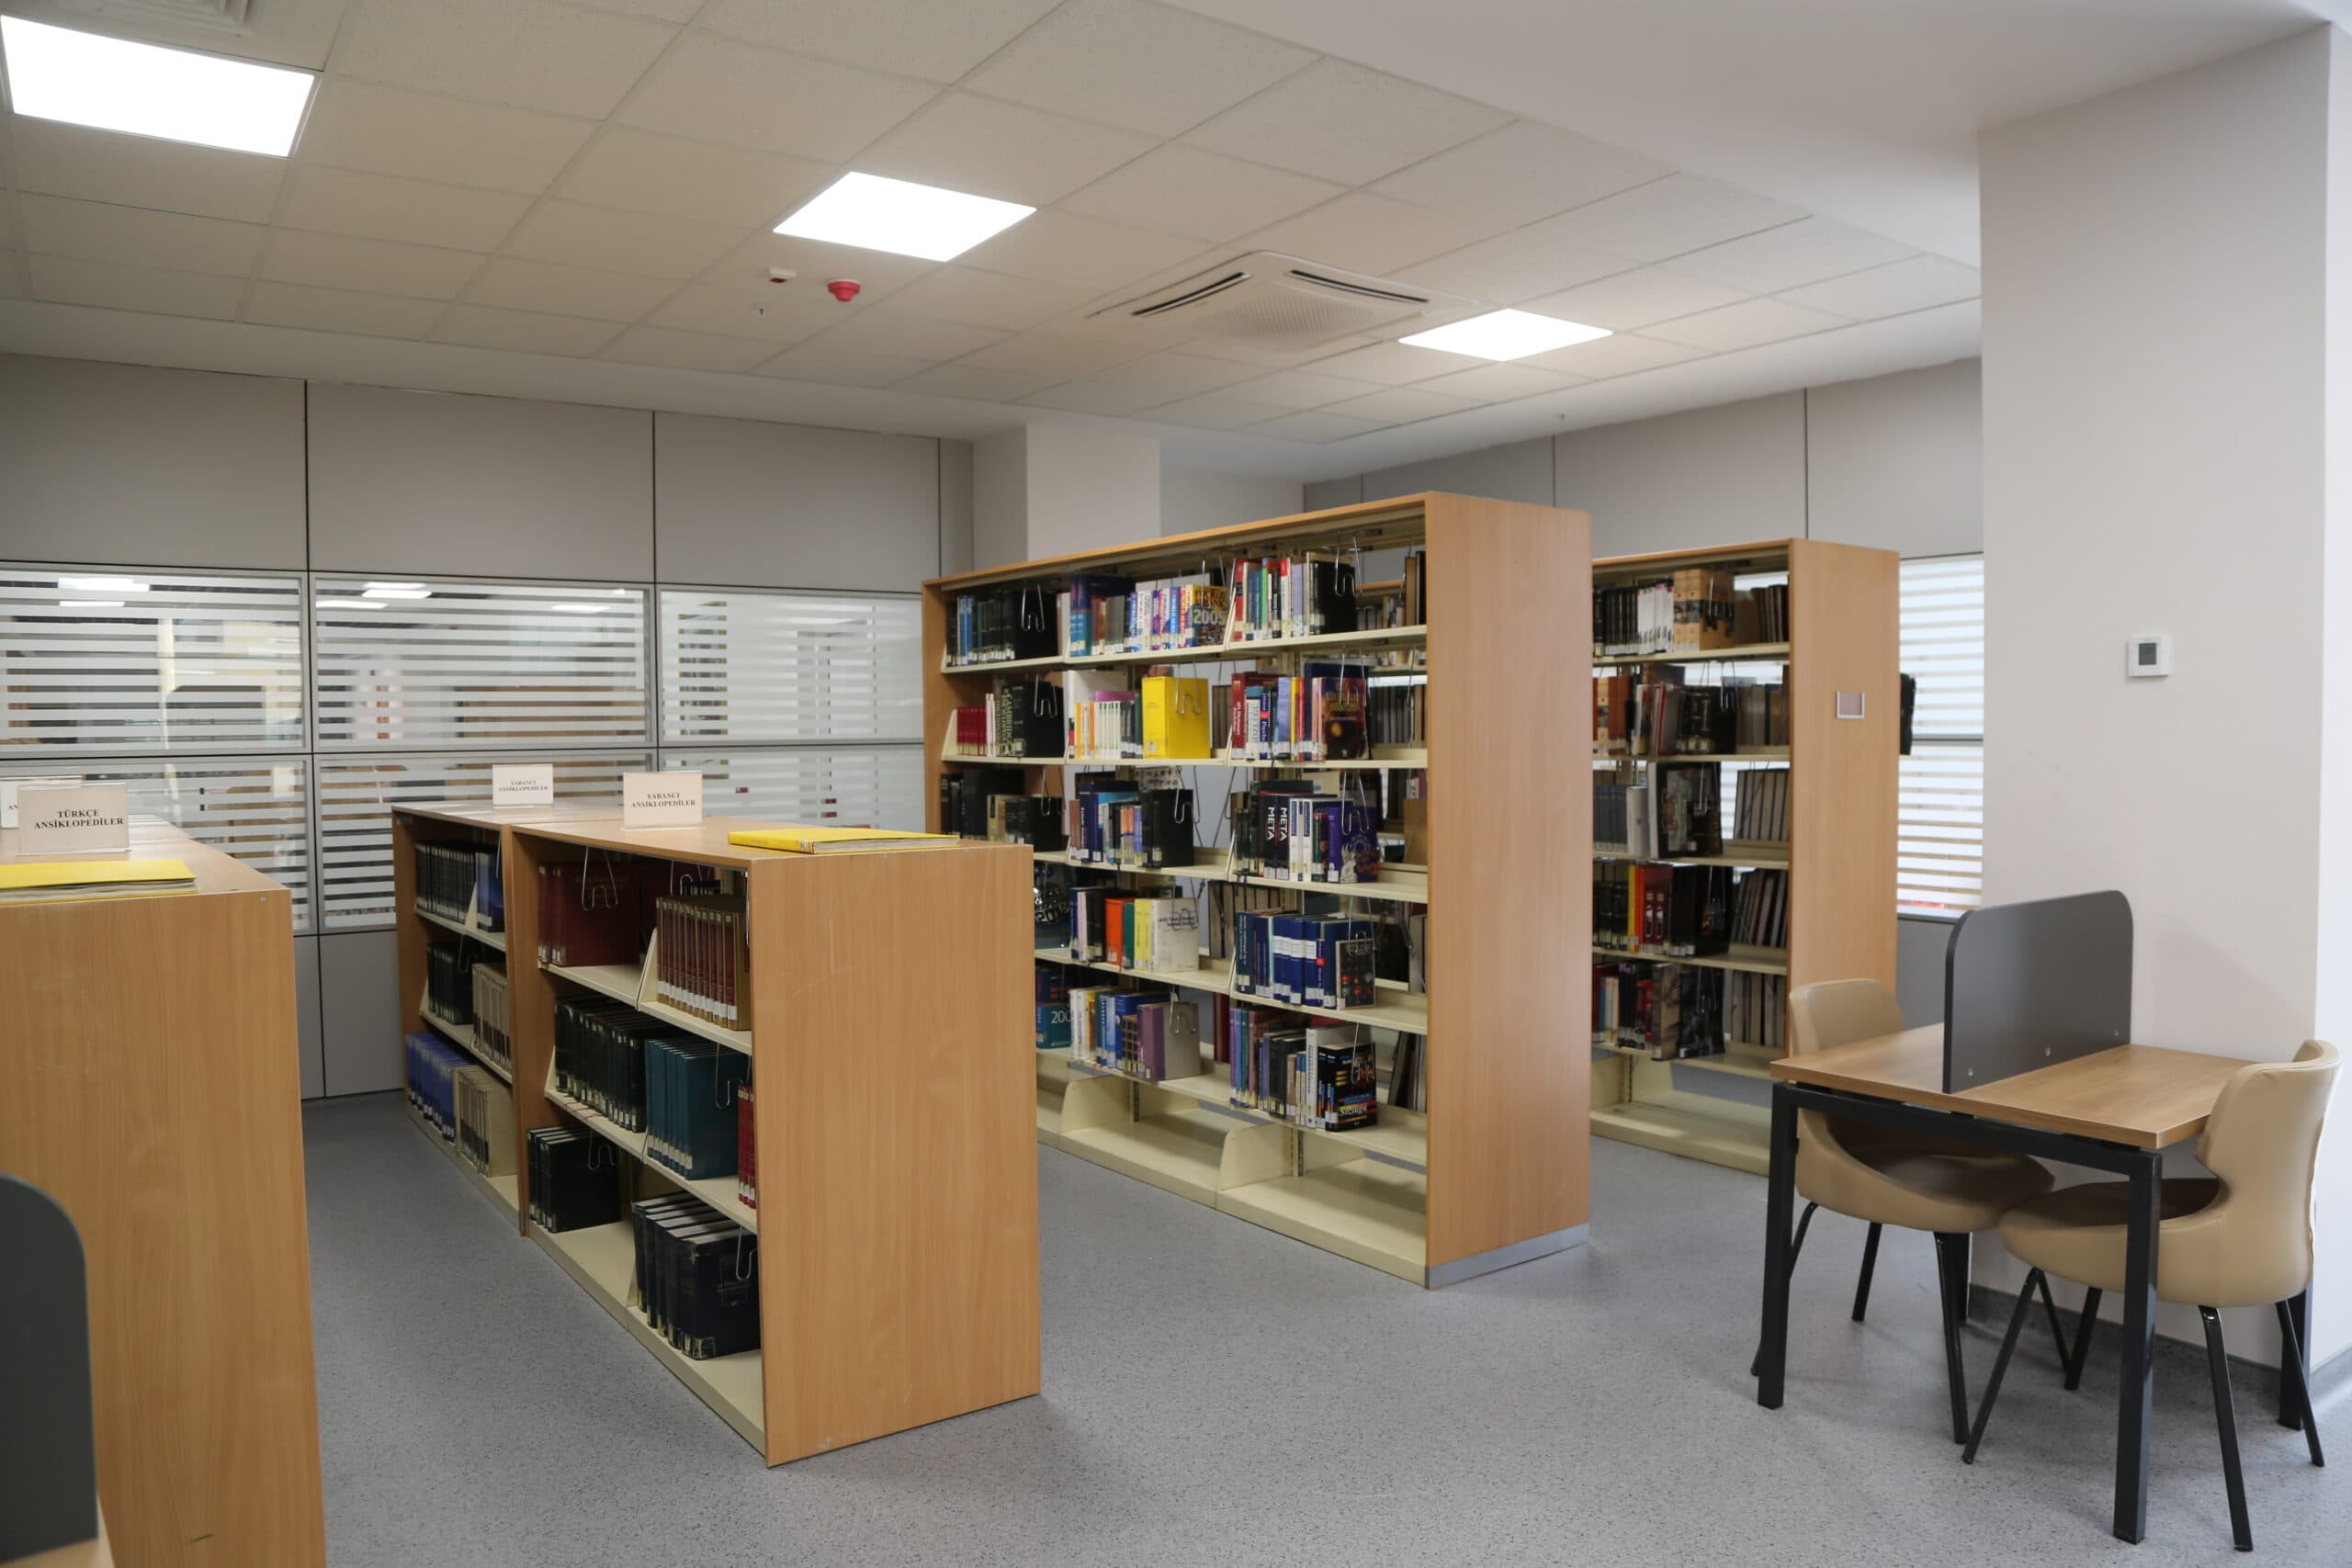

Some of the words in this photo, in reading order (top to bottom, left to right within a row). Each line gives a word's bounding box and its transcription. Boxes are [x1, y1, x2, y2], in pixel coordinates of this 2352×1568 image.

[647, 792, 681, 800] YABANCI
[630, 799, 696, 809] ANSİKLOPEDİLER
[57, 809, 100, 818] TÜRKÇE
[34, 818, 124, 829] ANSİKLOPEDİLER
[1267, 807, 1275, 840] META
[1280, 807, 1288, 841] META
[1051, 1010, 1071, 1024] 200
